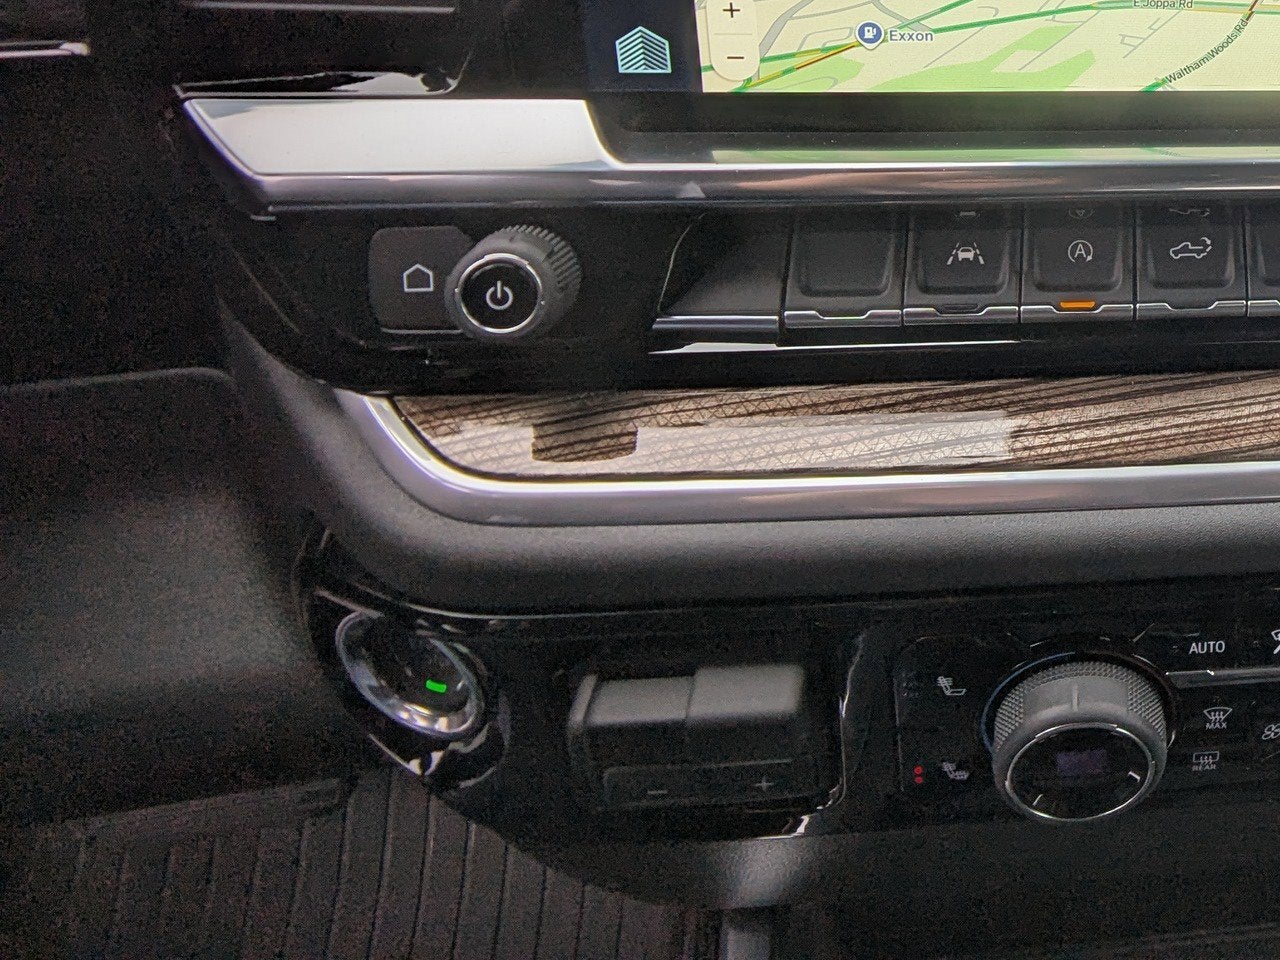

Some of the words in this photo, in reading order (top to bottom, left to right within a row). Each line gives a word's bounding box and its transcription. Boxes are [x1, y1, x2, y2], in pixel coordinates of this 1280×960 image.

[889, 29, 934, 43] Exxon
[1165, 53, 1211, 84] Waltham
[1208, 31, 1239, 60] Woods
[1234, 18, 1249, 36] Rd
[1188, 640, 1226, 655] AUTO
[1205, 721, 1227, 730] MAX
